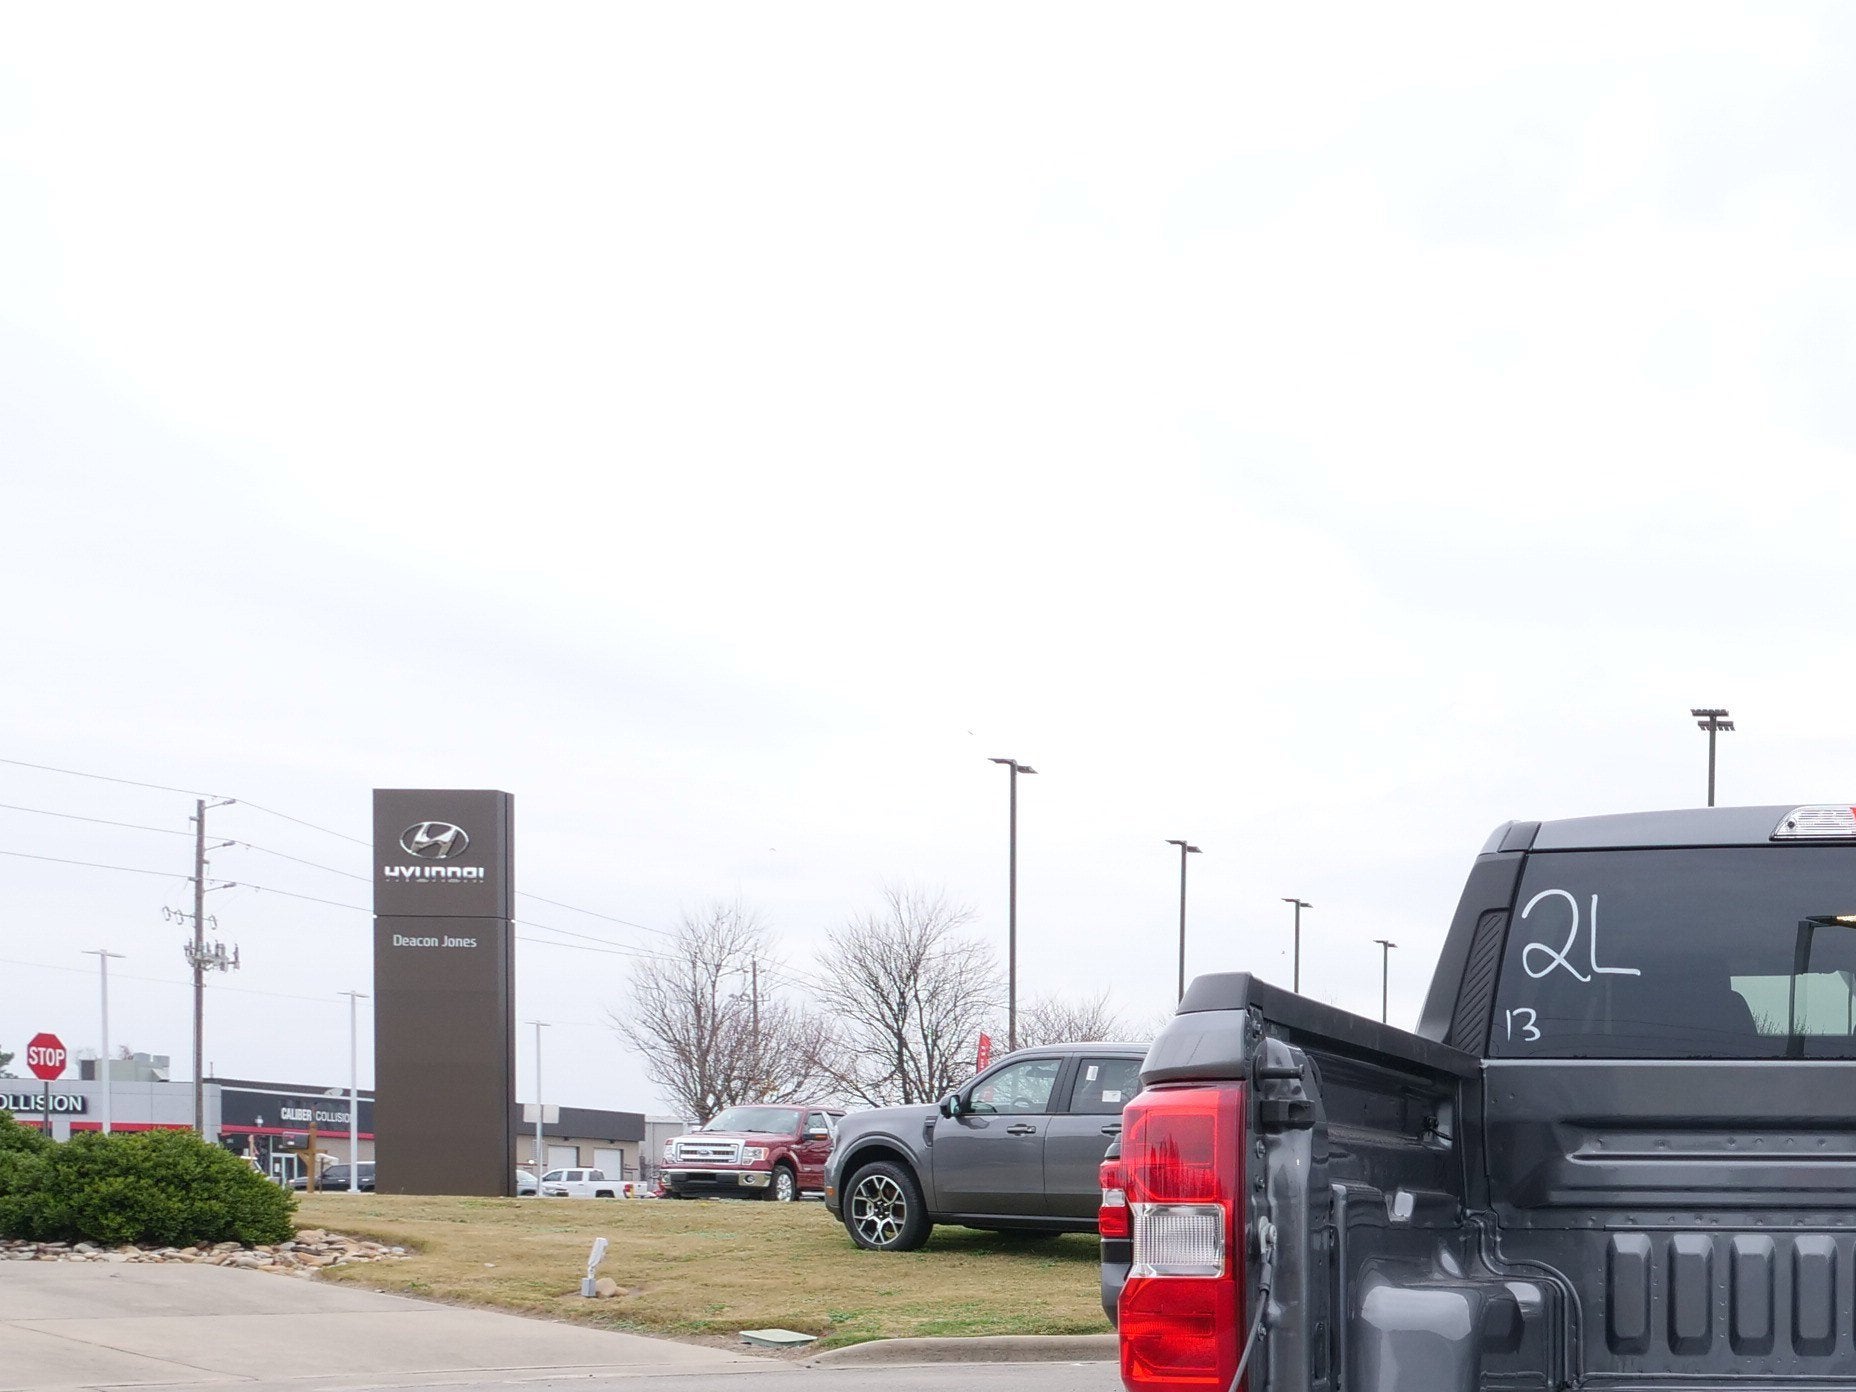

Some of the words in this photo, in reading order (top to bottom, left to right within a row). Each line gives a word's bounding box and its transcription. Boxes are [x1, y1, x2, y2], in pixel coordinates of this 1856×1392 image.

[393, 934, 438, 946] Deacon
[441, 935, 477, 947] Jones
[1521, 888, 1642, 982] 2L
[1506, 1007, 1541, 1042] 13
[29, 1047, 65, 1066] STOP
[281, 1107, 312, 1121] CALIBER
[315, 1111, 351, 1123] COLLISIO
